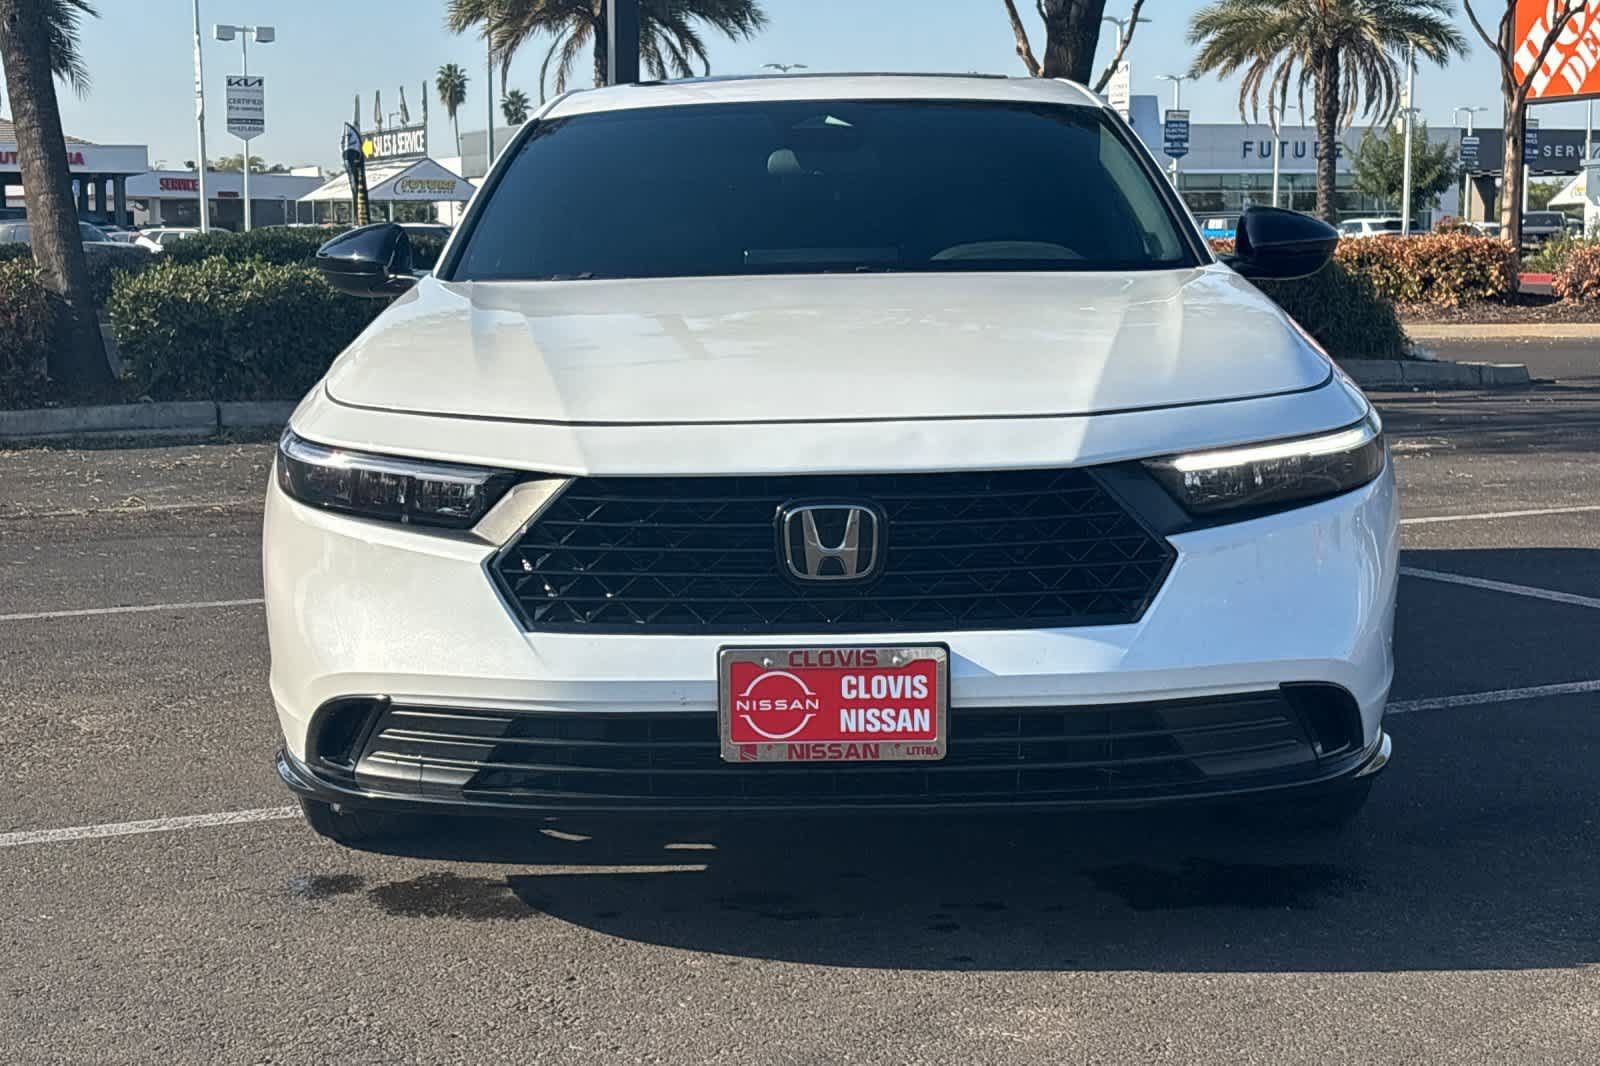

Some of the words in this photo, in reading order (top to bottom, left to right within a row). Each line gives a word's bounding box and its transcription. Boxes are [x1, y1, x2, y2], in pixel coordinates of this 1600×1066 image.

[227, 78, 263, 87] KIA
[373, 135, 391, 157] SALES
[397, 130, 424, 154] SERVICE
[1543, 145, 1586, 157] SERV
[160, 177, 199, 191] SERVICE
[789, 650, 878, 667] CLOVIS
[841, 674, 928, 699] CLOVIS
[736, 700, 819, 711] NISSAN
[840, 708, 930, 733] NISSAN
[788, 744, 880, 760] NISSAN
[906, 746, 938, 755] LITHIA
